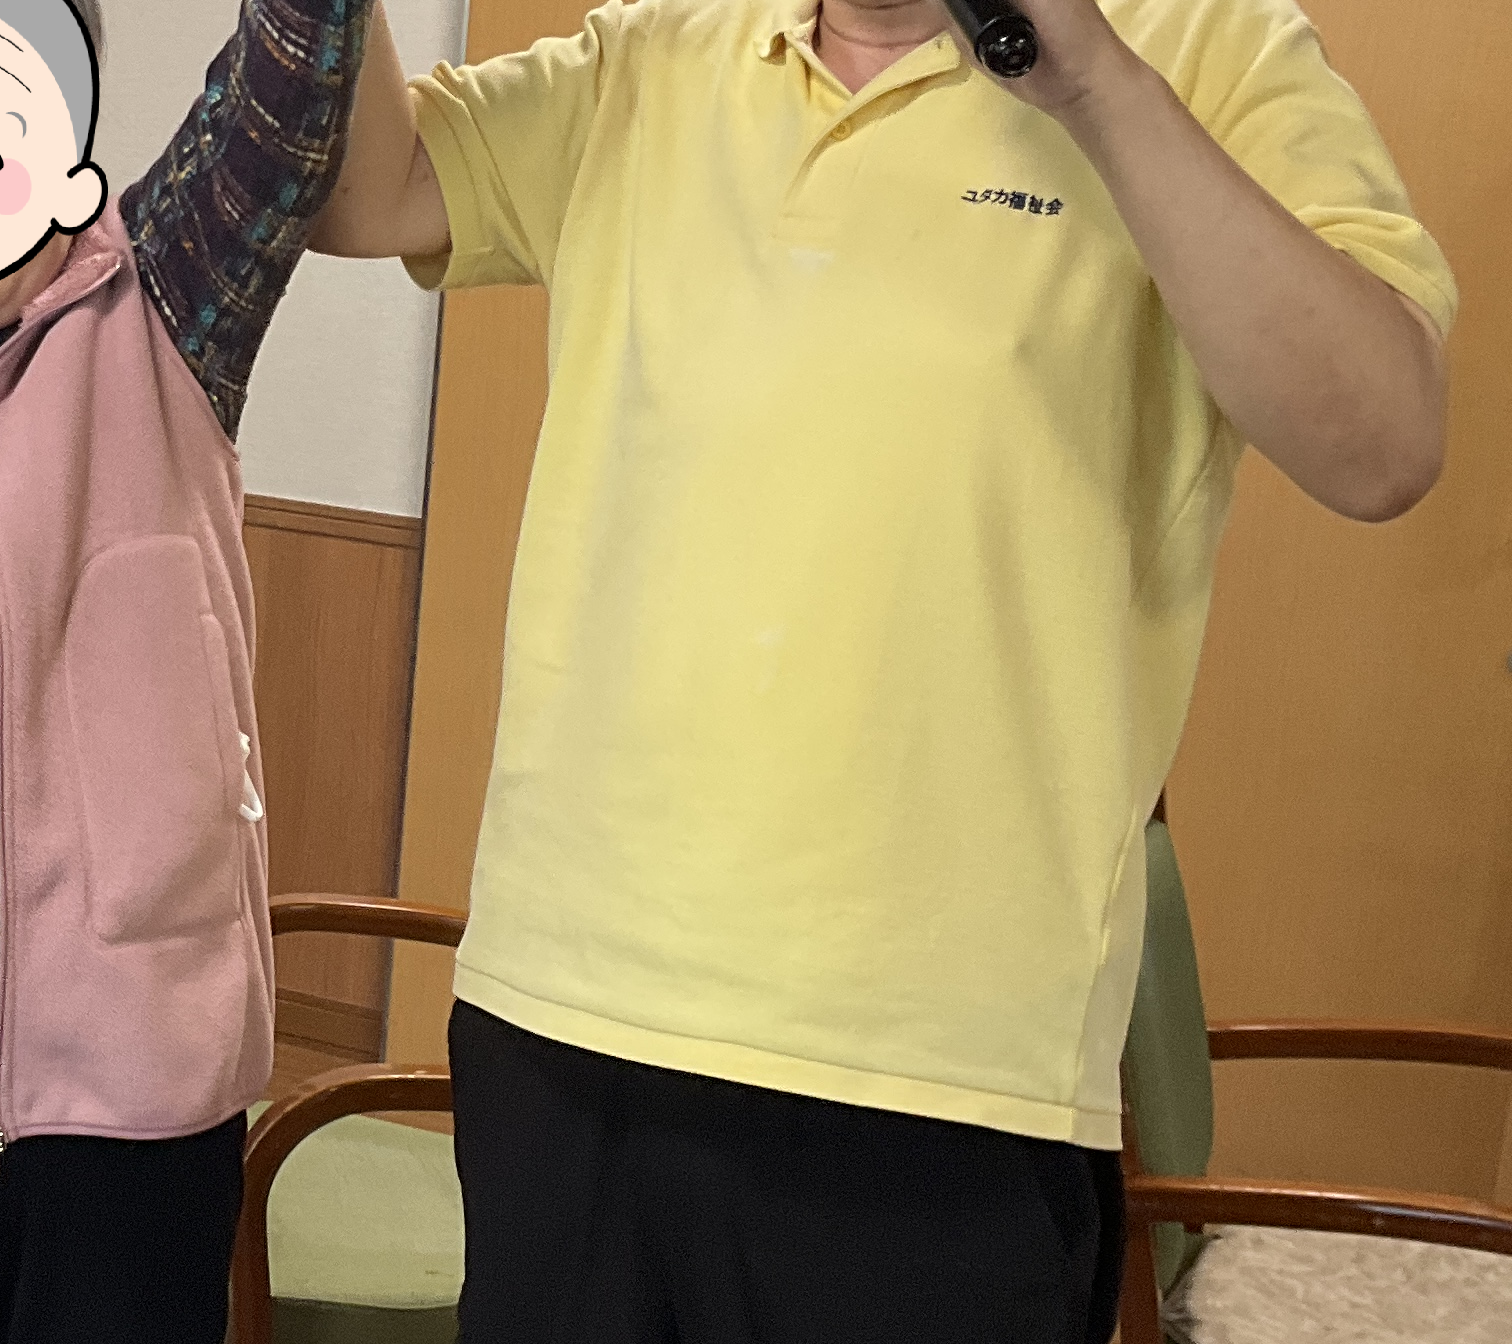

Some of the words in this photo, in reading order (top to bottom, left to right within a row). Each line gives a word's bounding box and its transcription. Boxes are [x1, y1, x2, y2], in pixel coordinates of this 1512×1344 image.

[961, 189, 1064, 216] ユタカ福祉会
